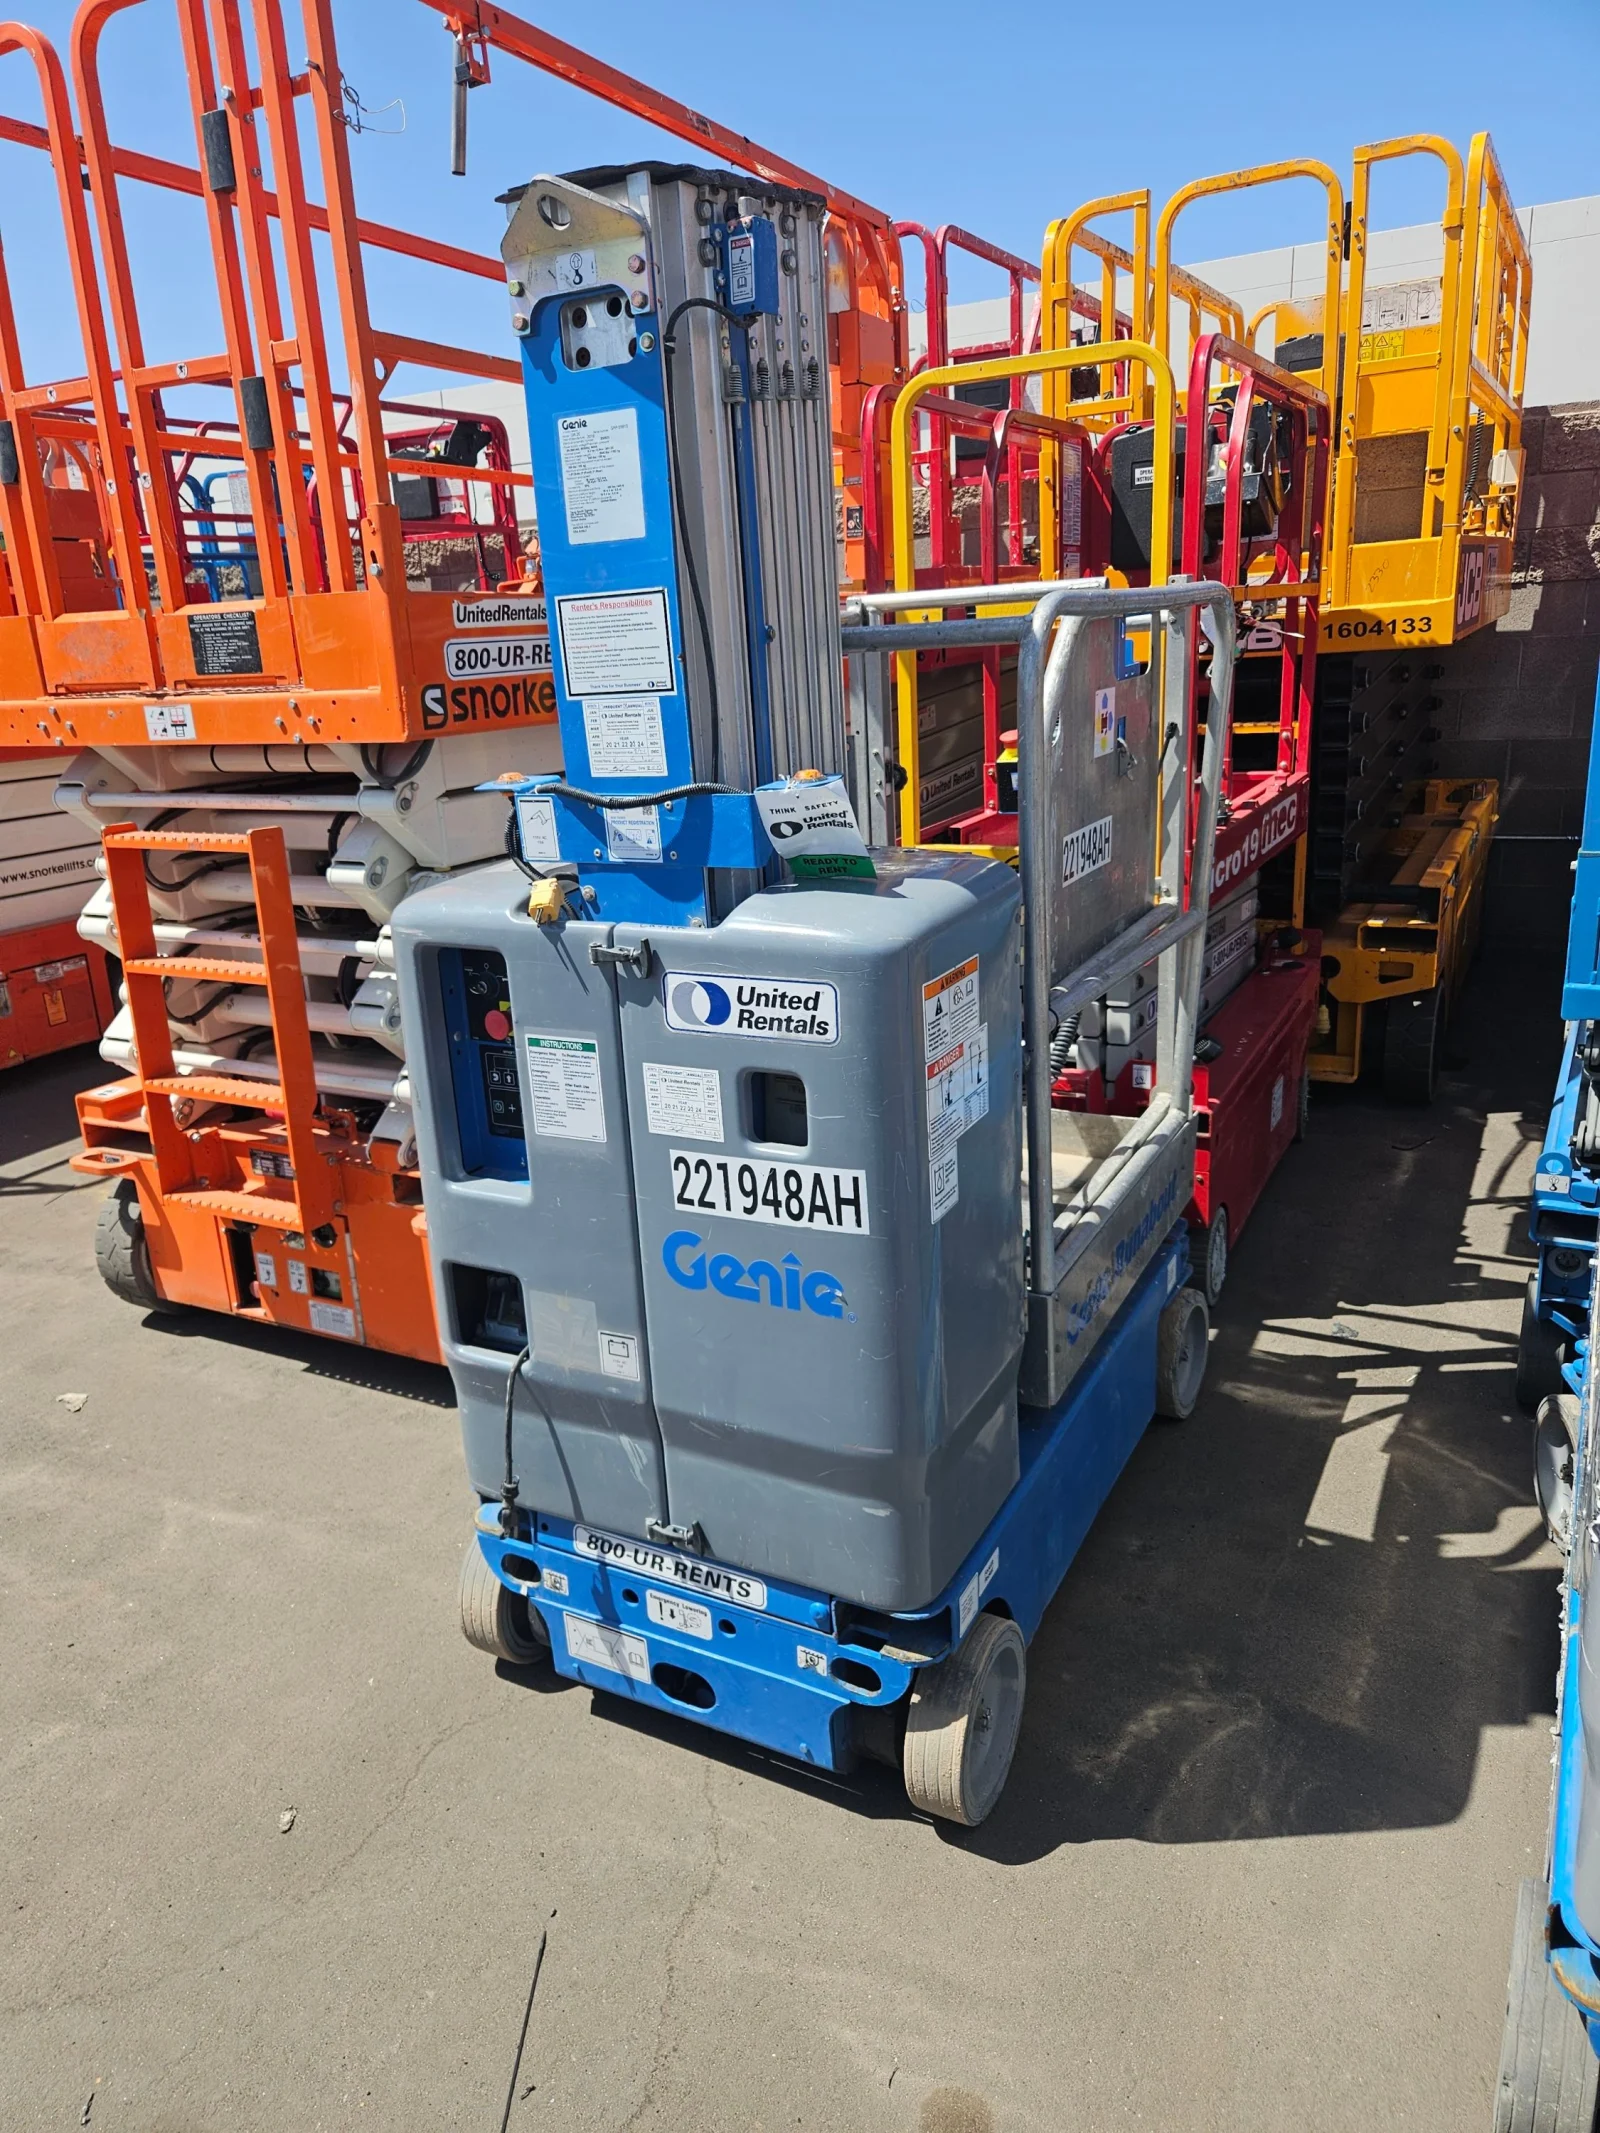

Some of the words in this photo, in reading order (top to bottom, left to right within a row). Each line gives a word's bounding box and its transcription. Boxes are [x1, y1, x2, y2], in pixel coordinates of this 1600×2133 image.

[562, 419, 587, 430] Genie
[1457, 551, 1484, 624] JCB
[456, 604, 547, 623] UnitedRentals
[571, 603, 598, 612] Renter's
[600, 599, 653, 611] Responsibilities
[1323, 617, 1432, 640] 1604133
[769, 807, 796, 815] THINK
[804, 800, 838, 811] SAFETY
[803, 810, 847, 823] United
[807, 820, 854, 830] Rentals
[1064, 820, 1110, 882] 221948AH
[803, 858, 838, 866] READY
[841, 858, 857, 866] TO
[818, 866, 848, 875] RENT
[945, 967, 965, 985] WARNING
[737, 986, 821, 1011] United
[737, 1009, 829, 1036] Rentals
[540, 1040, 583, 1051] INSTRUCTIONS
[938, 1047, 960, 1070] DANGER
[673, 1156, 862, 1228] 221948AH
[662, 1230, 844, 1319] Genie
[586, 1534, 752, 1598] 800-UR-RENTS
[650, 1593, 679, 1607] Emergency
[682, 1604, 707, 1617] Lowering
